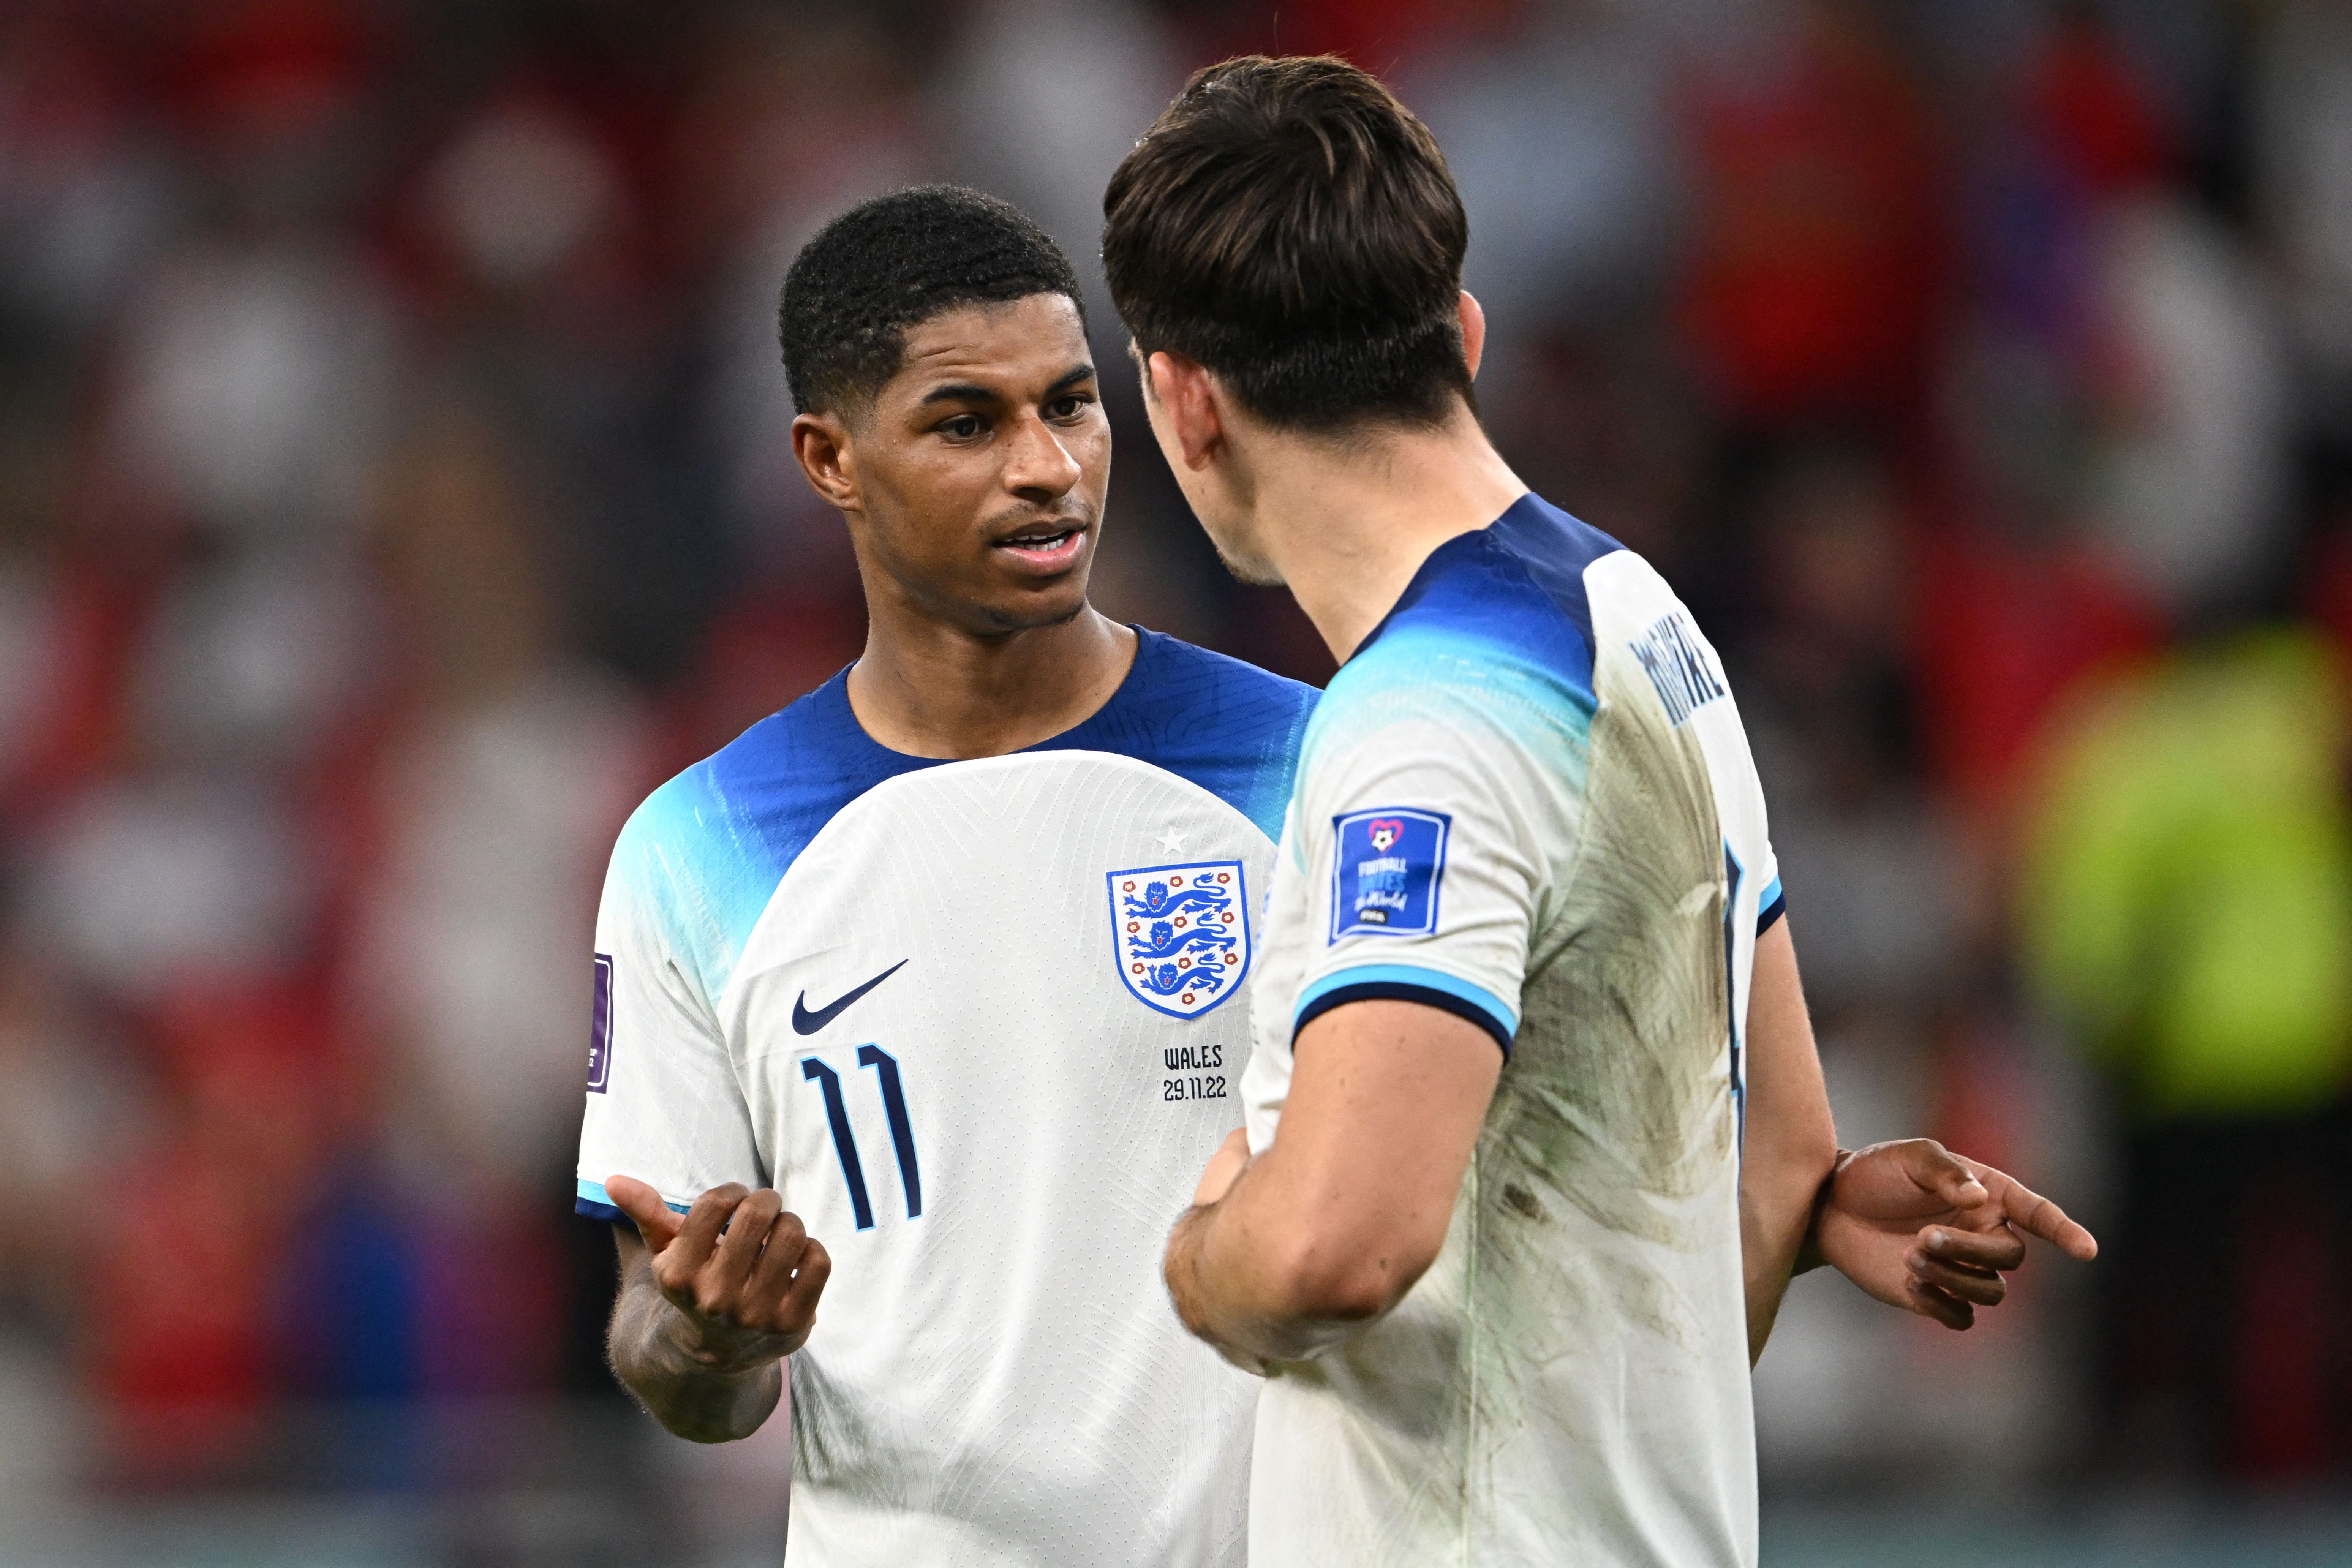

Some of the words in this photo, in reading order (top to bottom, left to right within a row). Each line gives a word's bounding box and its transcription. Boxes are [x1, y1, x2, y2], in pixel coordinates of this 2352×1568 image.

[1164, 1045, 1222, 1070] WALES
[1163, 1075, 1227, 1101] 29.11.22
[799, 1042, 923, 1233] 11
